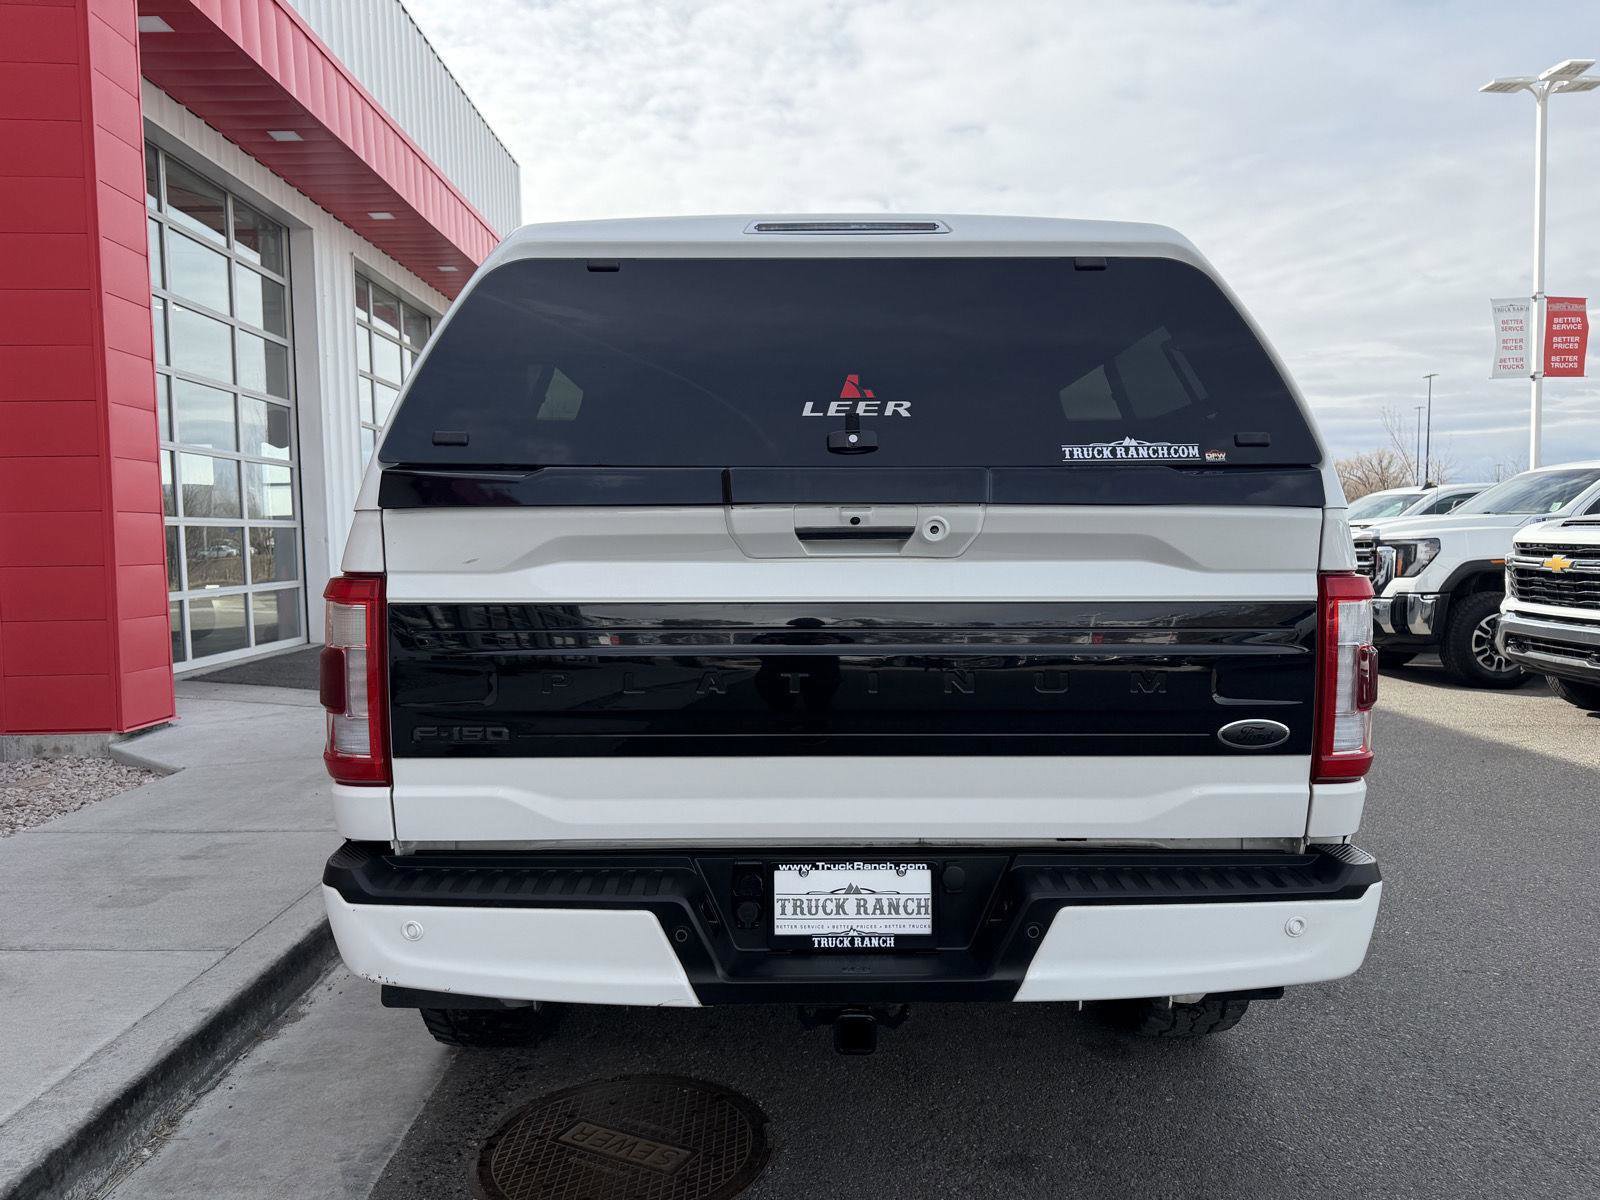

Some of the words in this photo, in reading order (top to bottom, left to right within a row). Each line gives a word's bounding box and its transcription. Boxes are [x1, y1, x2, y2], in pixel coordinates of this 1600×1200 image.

[802, 401, 912, 417] LEER
[1062, 447, 1114, 460] TRUCK
[1116, 446, 1200, 459] RANCH.COM
[541, 671, 1168, 696] PLATINUM
[411, 725, 512, 744] F-150
[778, 862, 928, 870] www.TruckRanch.com
[776, 897, 850, 916] TRUCK
[854, 897, 930, 916] RANCH
[812, 936, 851, 948] TRUCK
[854, 936, 895, 948] RANCH
[572, 1127, 679, 1166] SEWER
